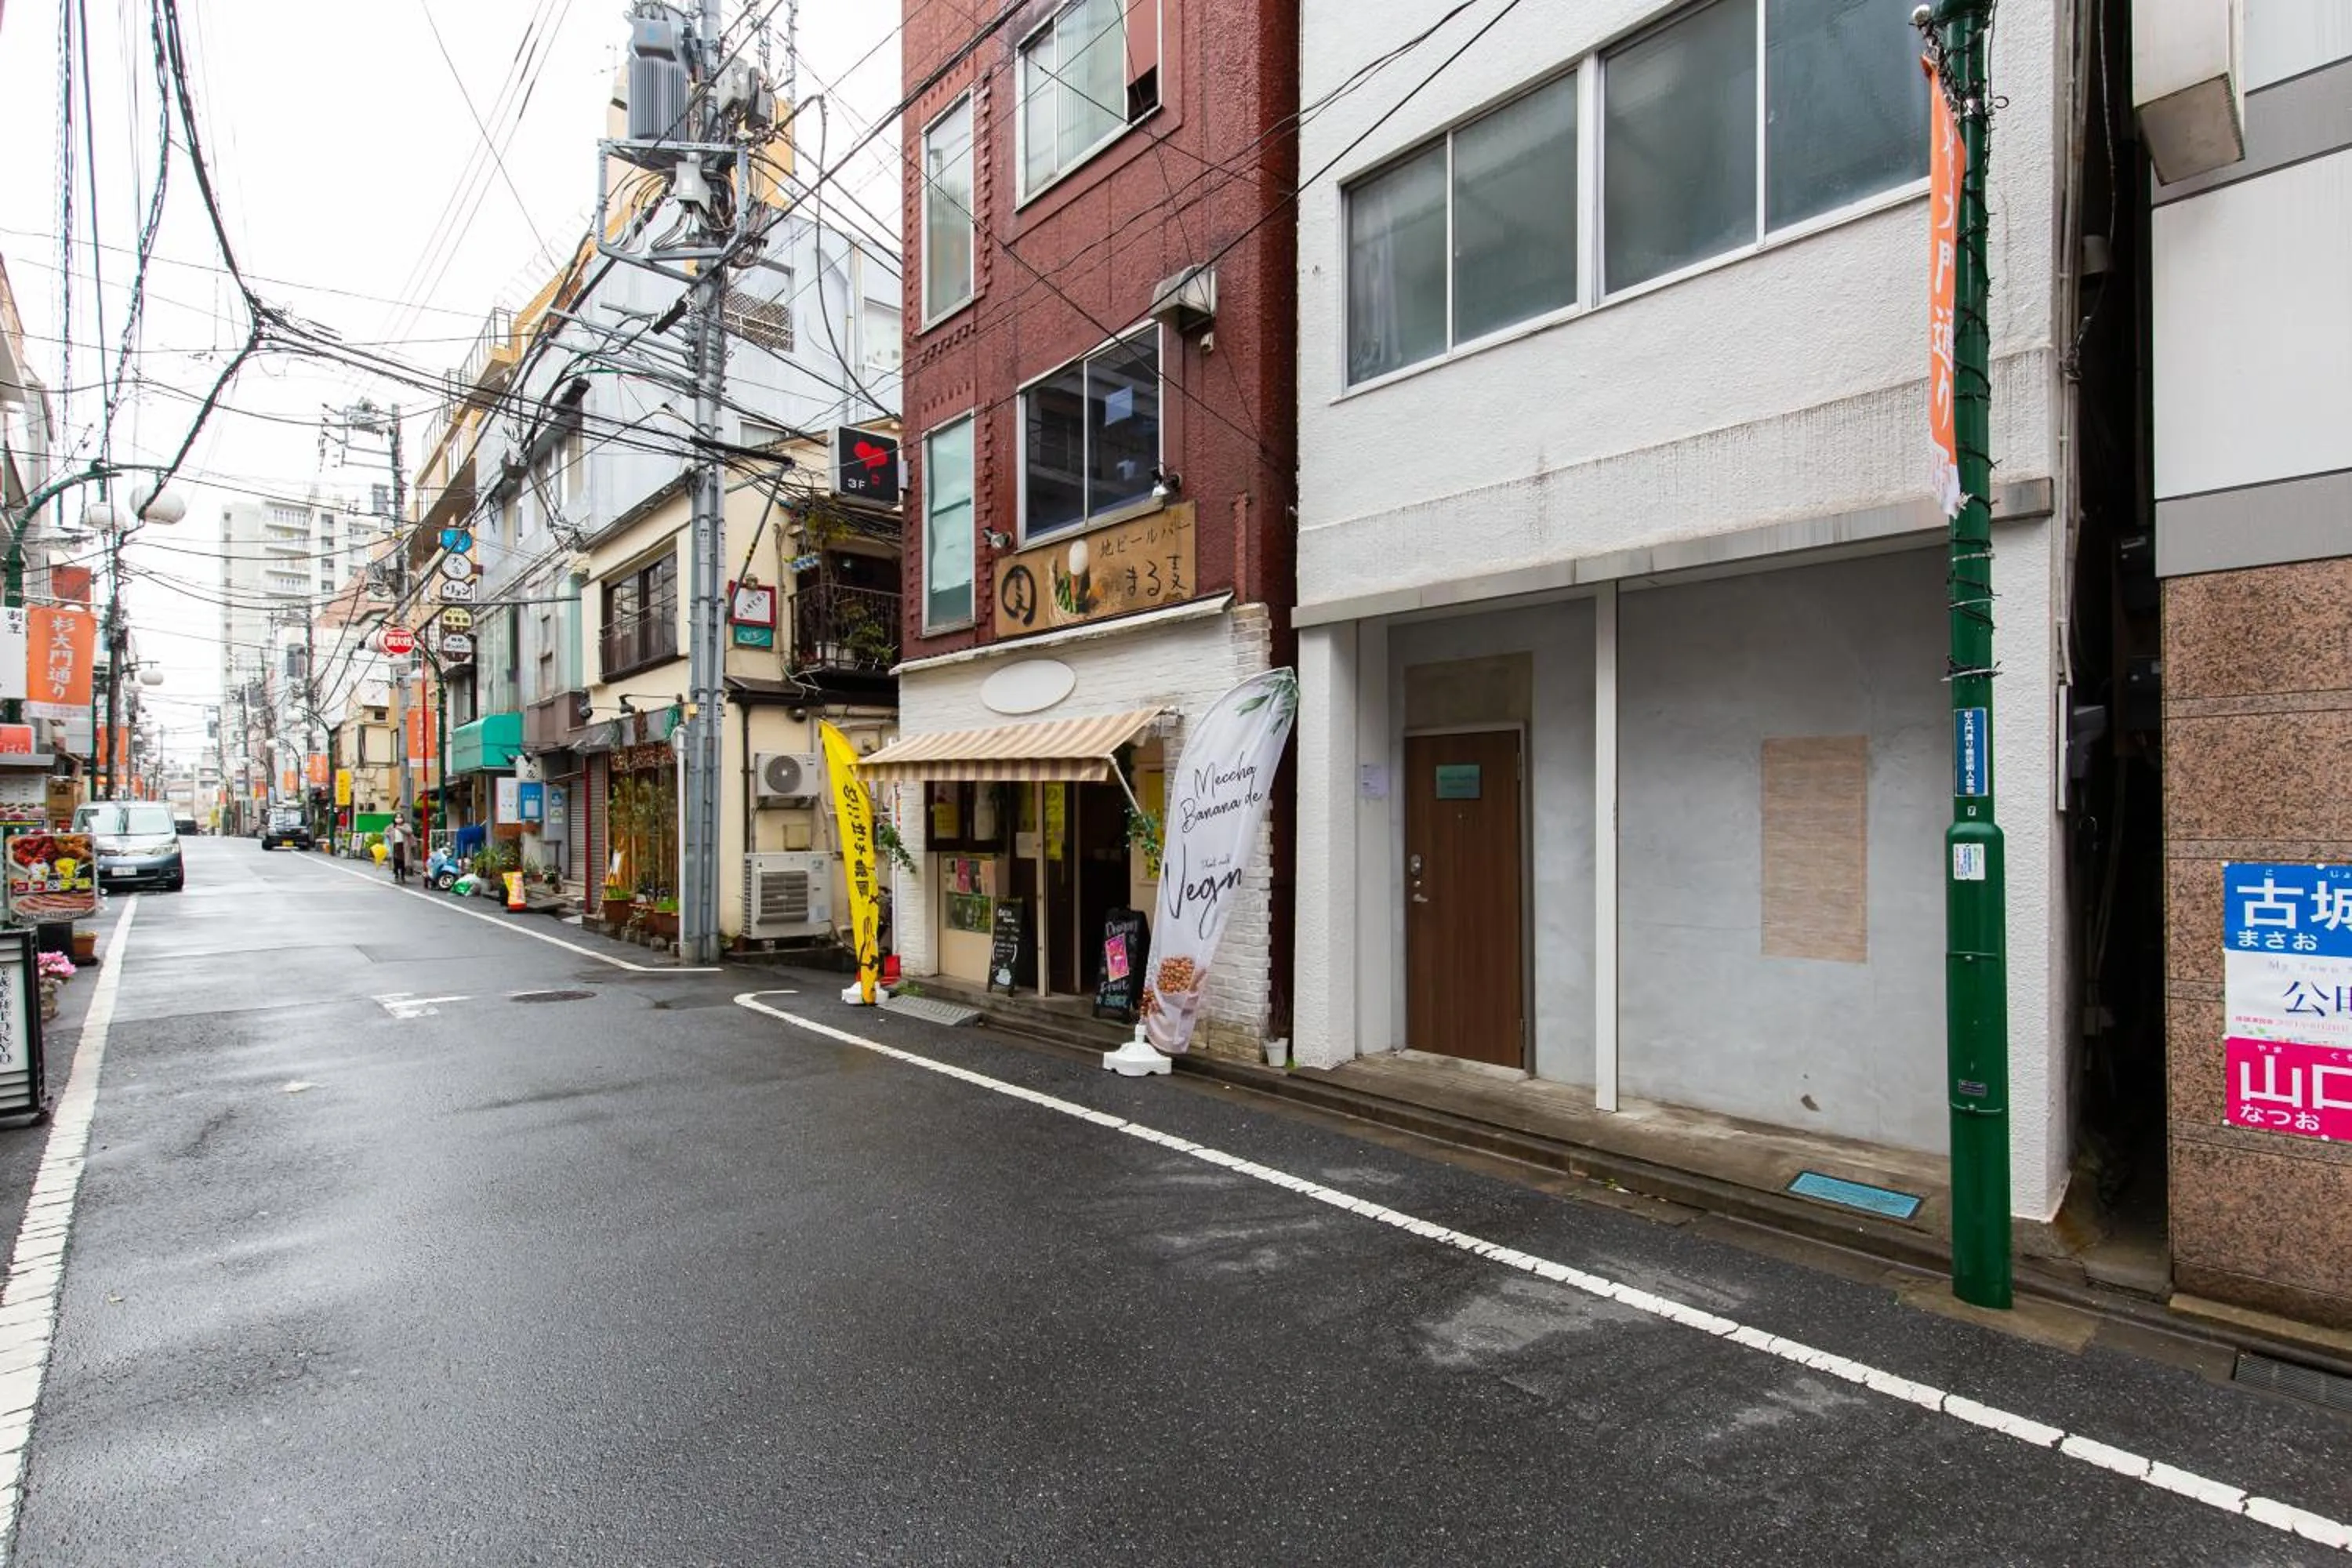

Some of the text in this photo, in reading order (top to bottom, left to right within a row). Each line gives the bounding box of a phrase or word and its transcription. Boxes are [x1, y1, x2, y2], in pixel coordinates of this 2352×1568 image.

[848, 477, 866, 489] 3F
[1100, 523, 1191, 558] 地ビールバー
[47, 616, 76, 699] 杉大門通り
[1195, 751, 1257, 799] Meccha
[1181, 797, 1241, 833] Banana
[2237, 930, 2318, 951] まさお
[2239, 1103, 2321, 1131] なつお
